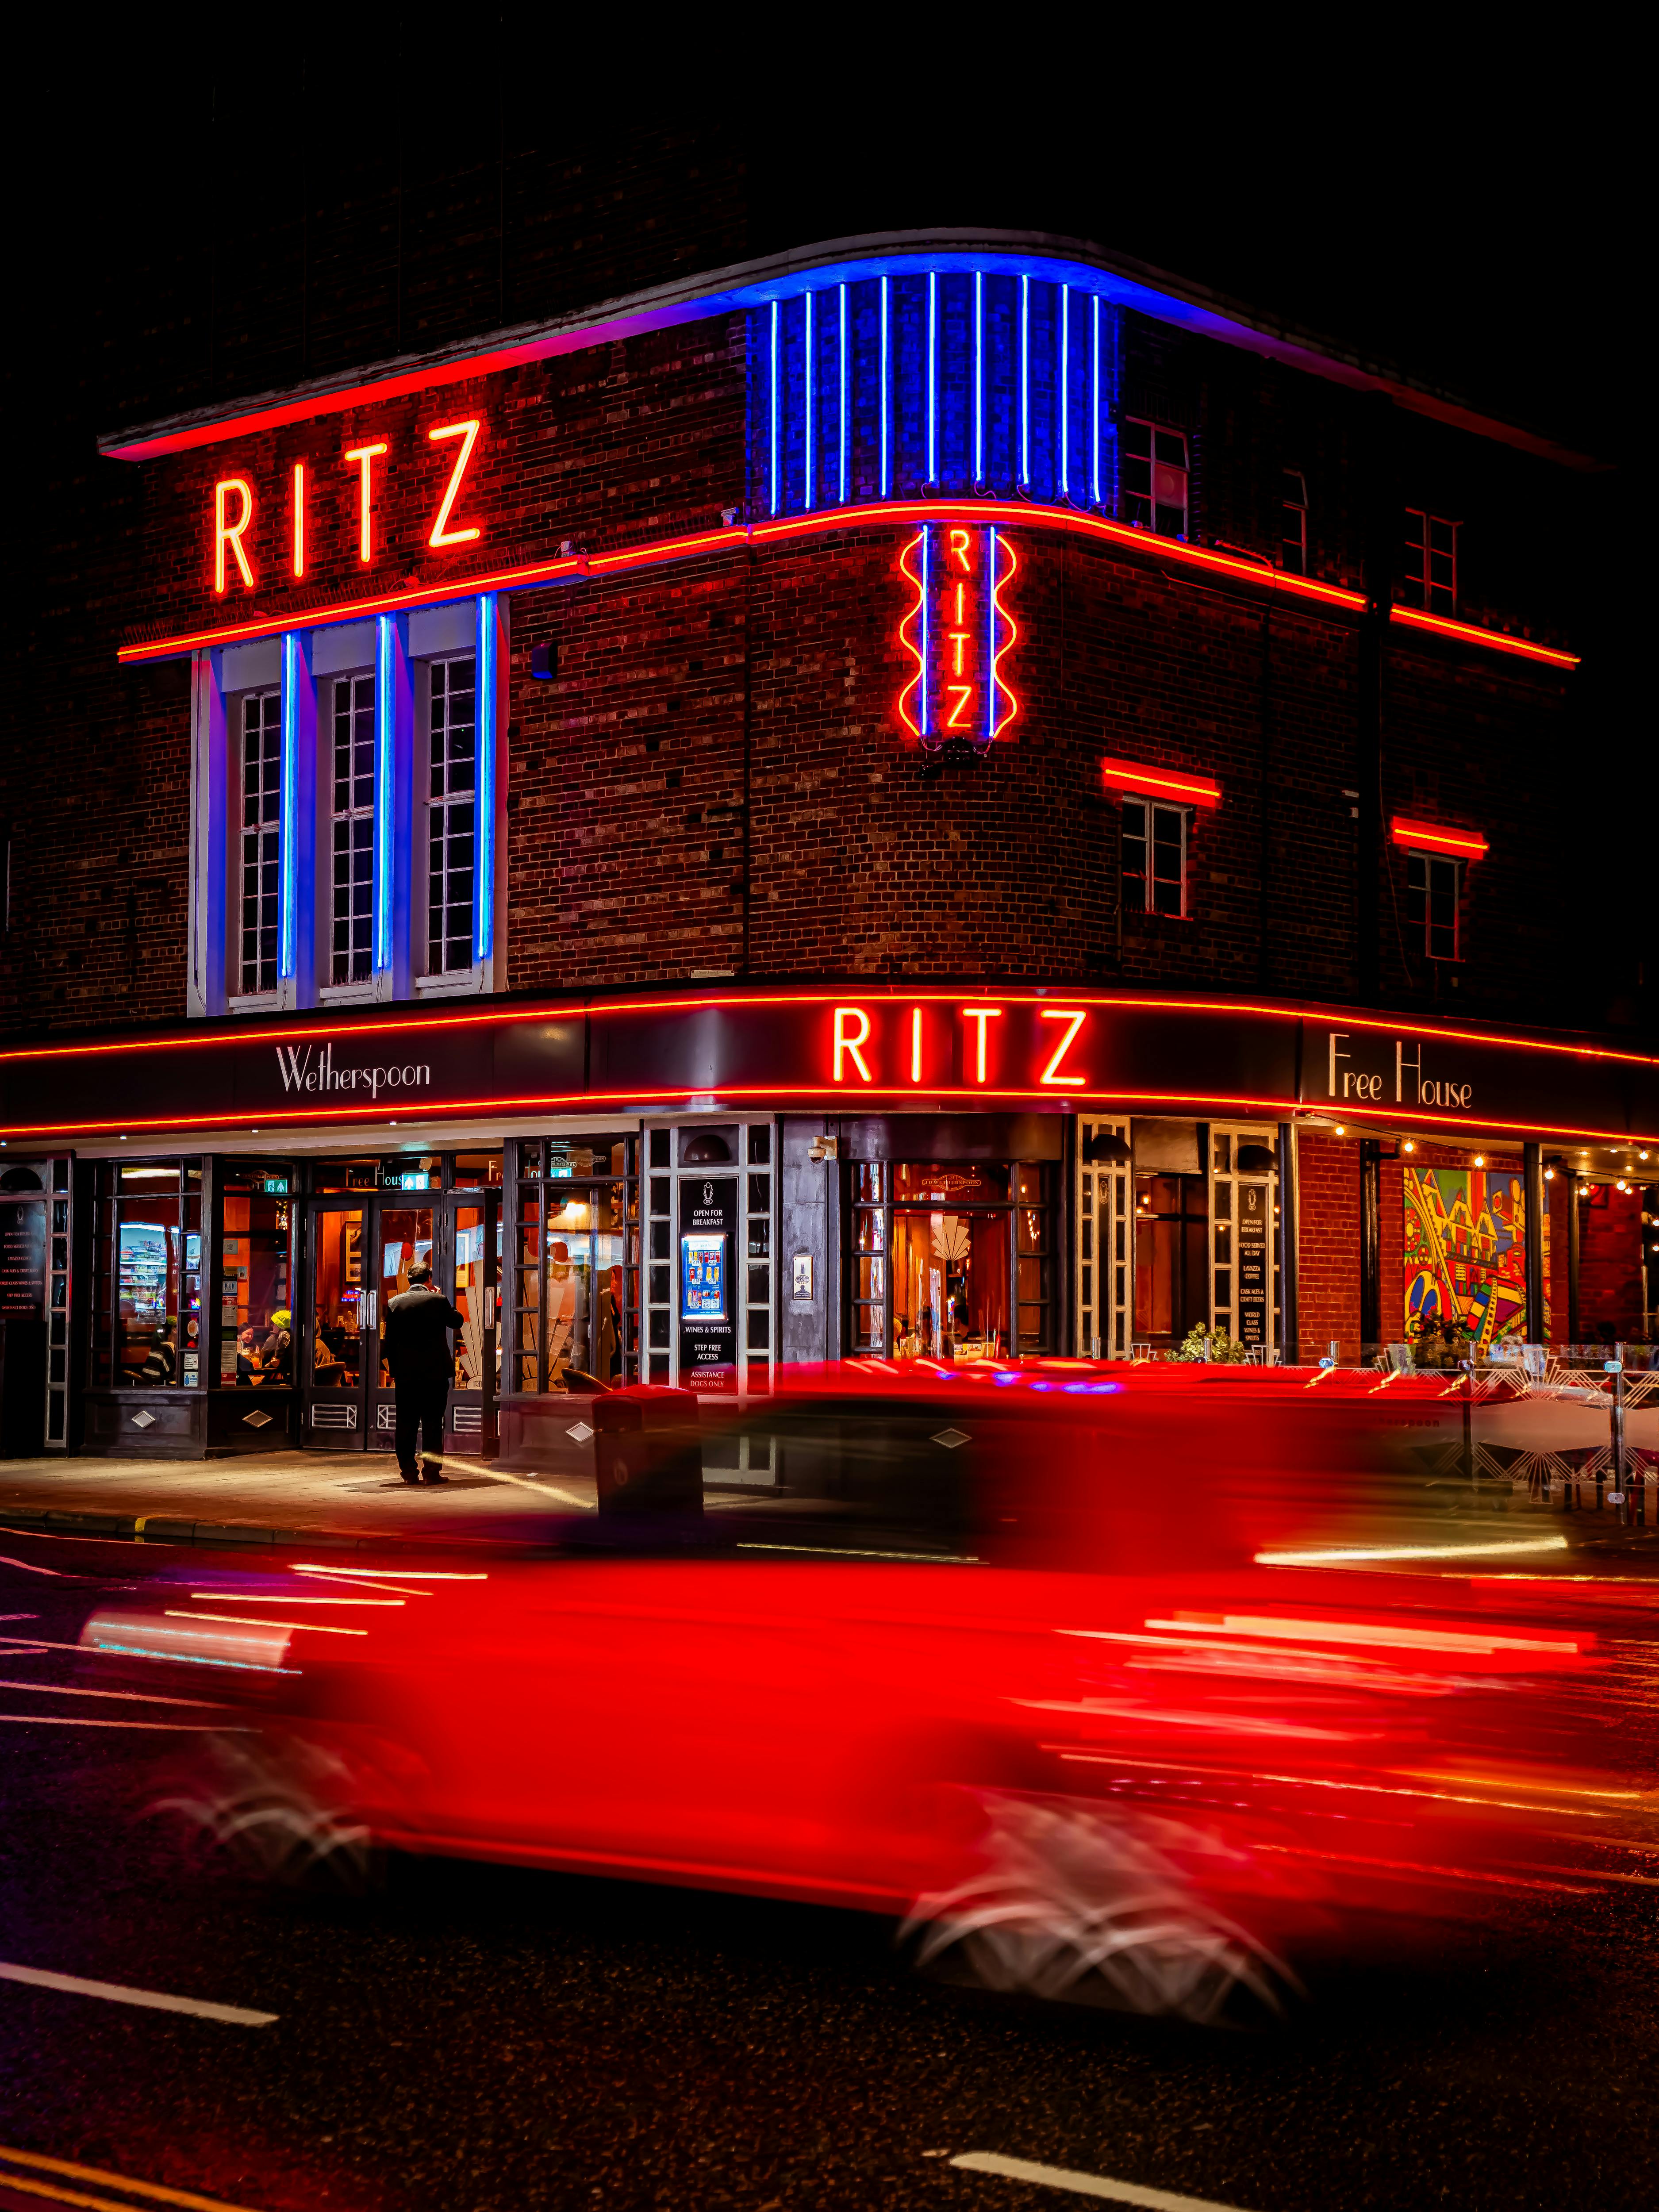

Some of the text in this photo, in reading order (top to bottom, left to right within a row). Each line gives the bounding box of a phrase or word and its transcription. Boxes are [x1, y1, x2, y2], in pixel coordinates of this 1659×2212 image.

[215, 420, 480, 593] RITZ
[948, 530, 972, 728] RITZ
[276, 1043, 430, 1099] Wetherspoon
[833, 1007, 1087, 1085] RITZ
[1329, 1033, 1472, 1108] Free House
[346, 1166, 402, 1187] Free Hous
